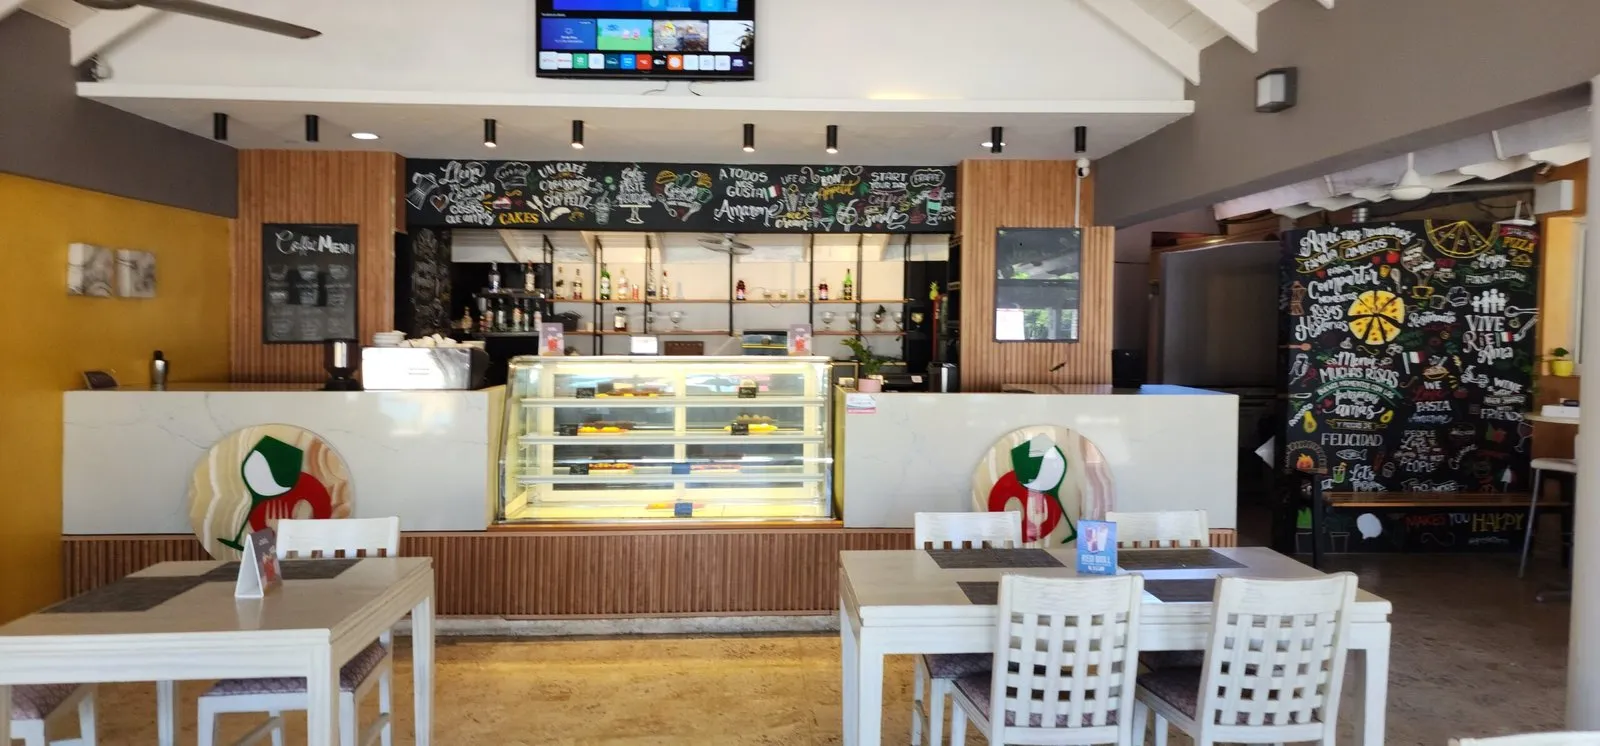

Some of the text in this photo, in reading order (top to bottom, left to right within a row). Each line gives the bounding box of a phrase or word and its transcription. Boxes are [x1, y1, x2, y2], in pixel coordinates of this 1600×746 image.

[538, 164, 557, 178] UN
[719, 167, 769, 183] A TODOS
[870, 172, 908, 182] START
[499, 211, 539, 226] CAKES
[1503, 236, 1535, 254] PIZZA
[1464, 314, 1506, 332] VIVE
[1477, 344, 1514, 366] Ama
[1423, 380, 1443, 390] WE
[1415, 400, 1453, 413] PASTA
[1320, 432, 1384, 447] FELICIDAD
[1403, 429, 1437, 438] PEOPLE
[1448, 512, 1471, 526] YOU
[1471, 511, 1526, 533] HAPPY
